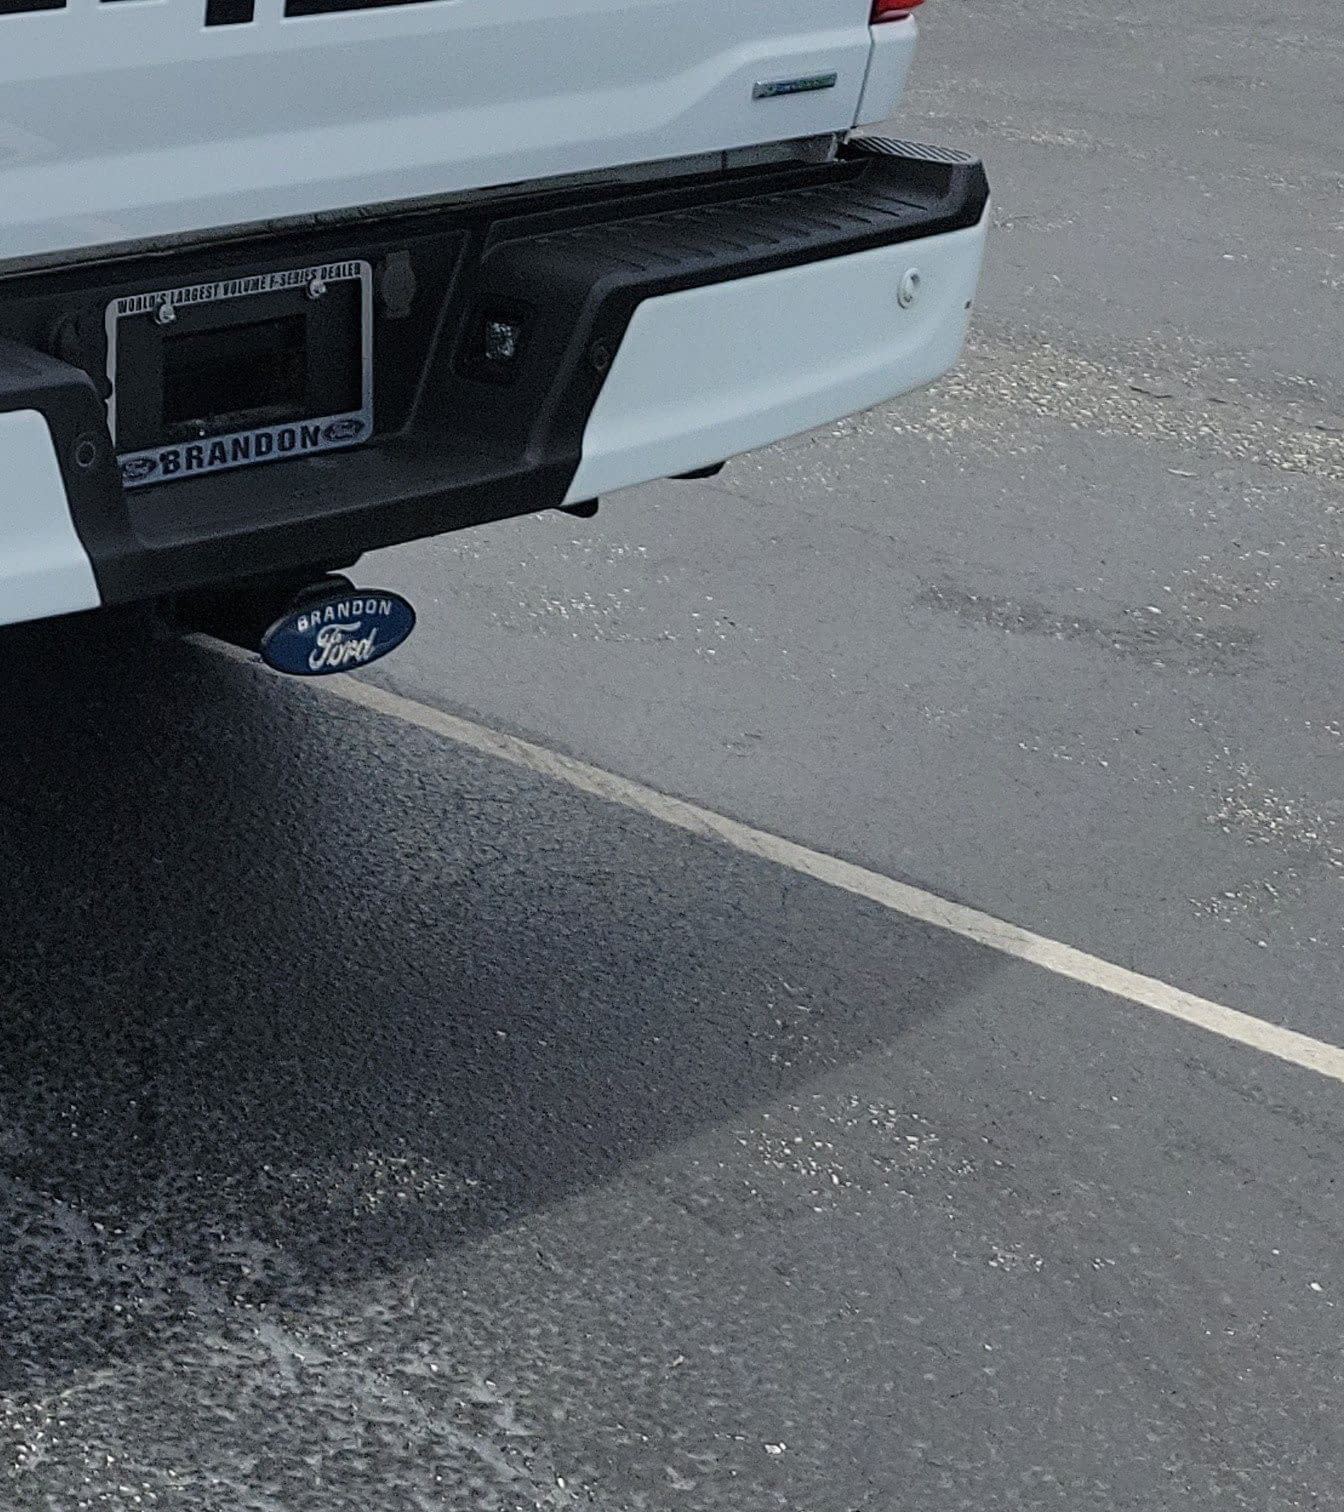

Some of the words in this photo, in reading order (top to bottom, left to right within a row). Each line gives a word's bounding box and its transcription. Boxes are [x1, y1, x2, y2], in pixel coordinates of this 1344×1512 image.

[116, 292, 167, 315] WORLD'S
[170, 285, 219, 306] LARGEST
[222, 276, 267, 298] VOLUME
[320, 261, 362, 281] DEALER
[160, 425, 321, 475] BRANDON
[296, 599, 392, 633] BRANDON
[308, 620, 378, 671] Ford
